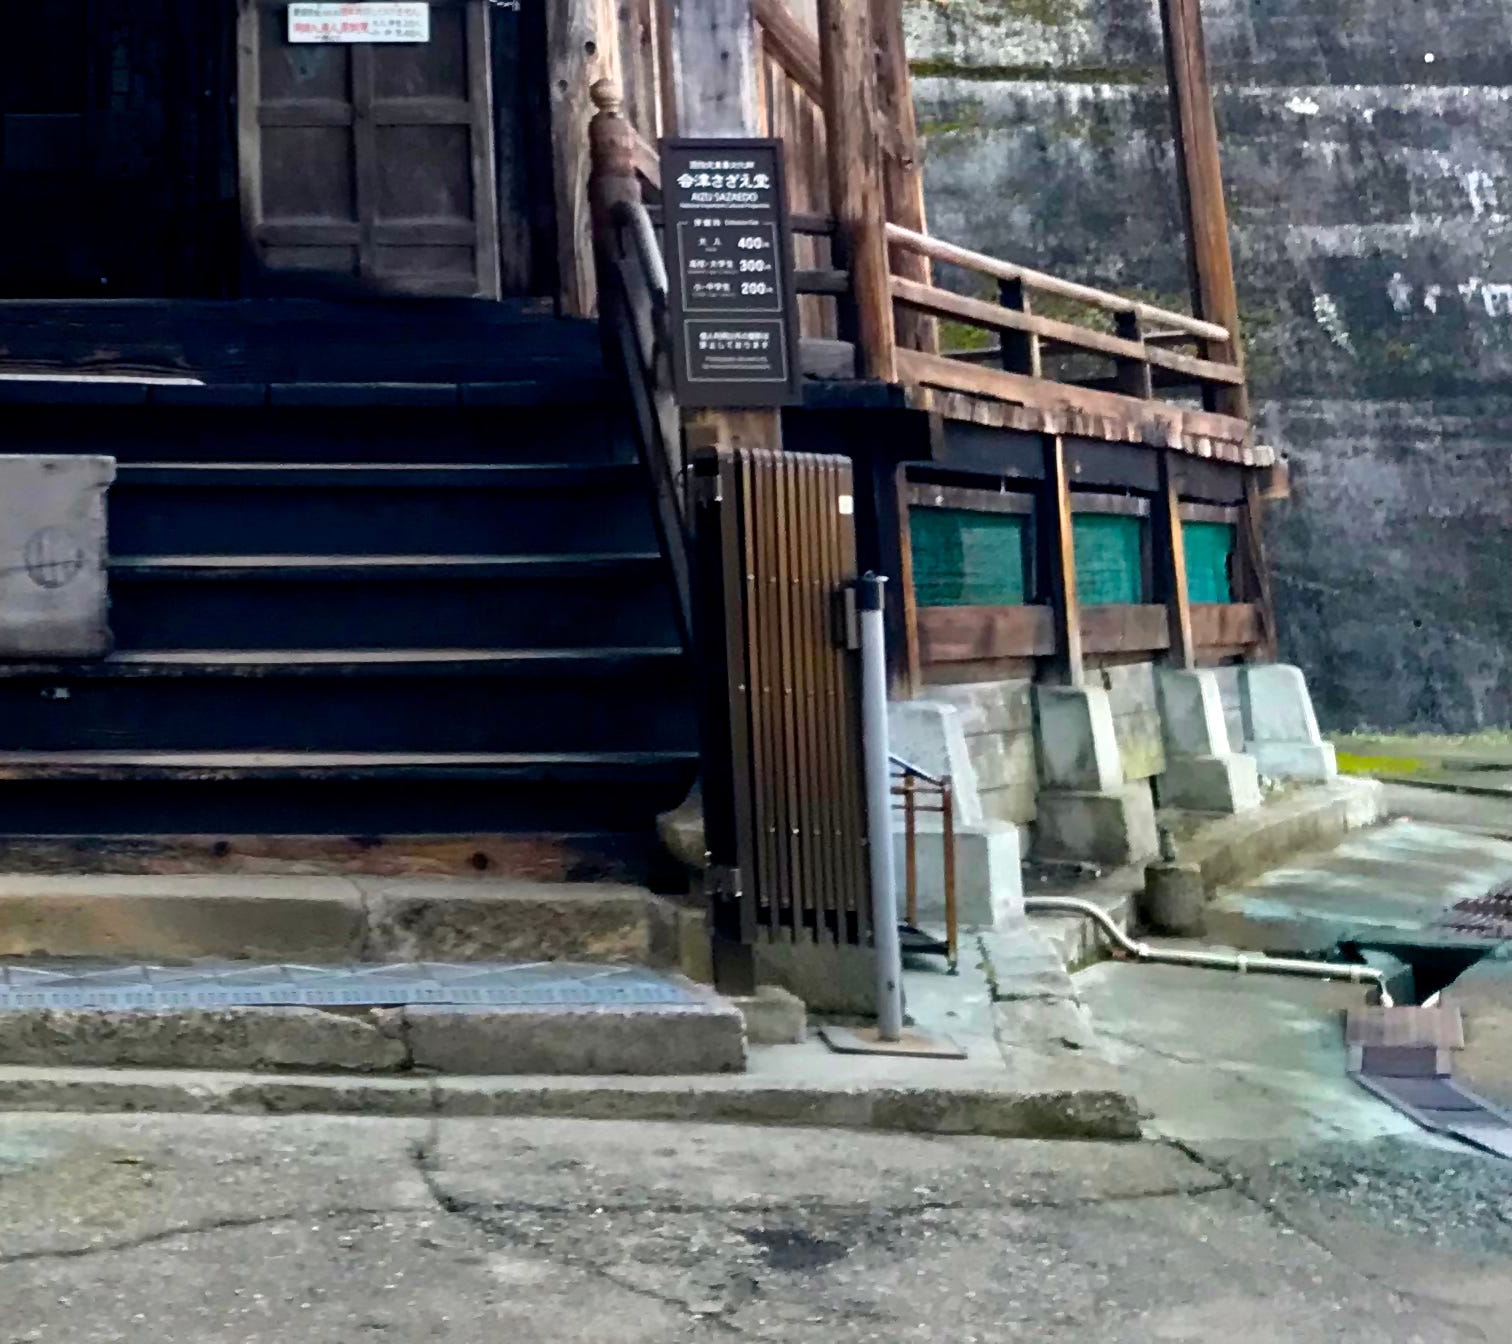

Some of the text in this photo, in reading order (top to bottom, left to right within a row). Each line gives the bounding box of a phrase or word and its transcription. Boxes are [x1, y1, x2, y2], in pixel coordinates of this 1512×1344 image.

[676, 173, 770, 189] 会津さざえ堂
